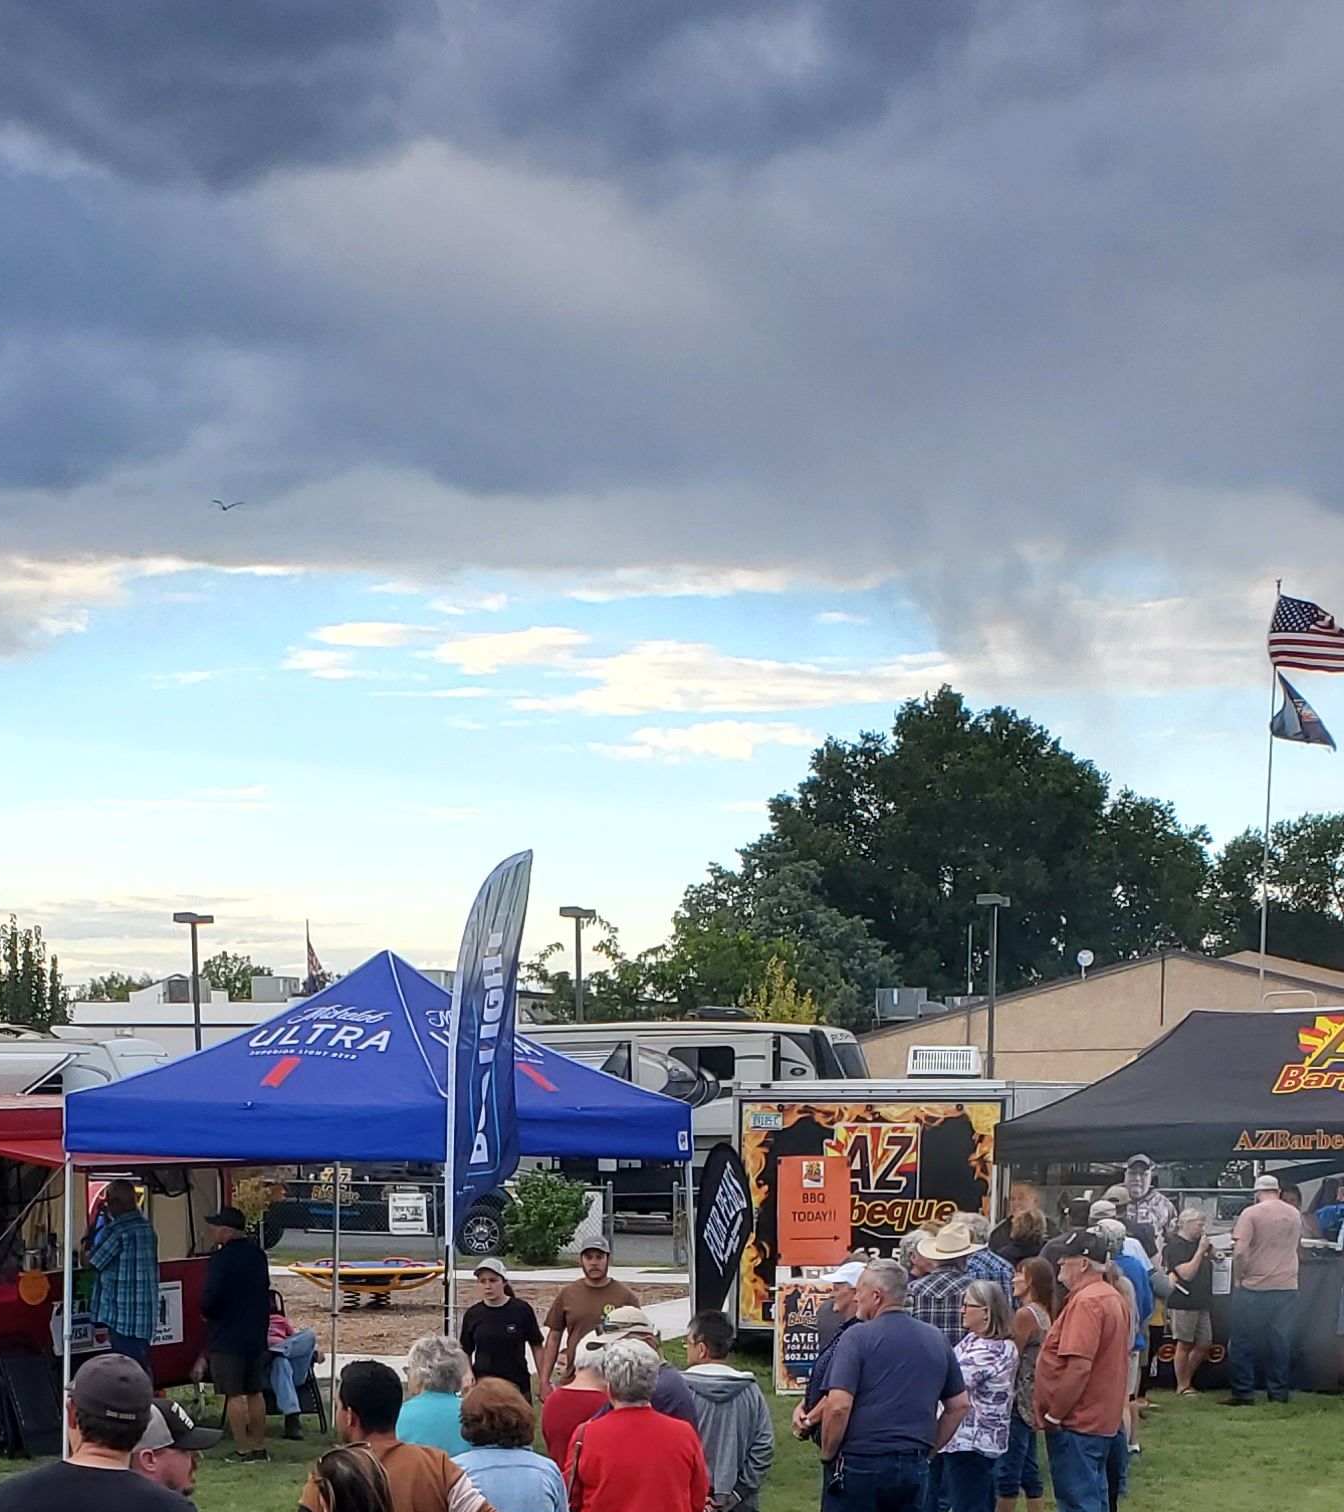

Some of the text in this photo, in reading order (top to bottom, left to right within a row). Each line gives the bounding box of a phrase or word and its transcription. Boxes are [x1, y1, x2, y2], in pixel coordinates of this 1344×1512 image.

[287, 1004, 392, 1024] Michelob
[248, 1022, 392, 1052] ULTRA
[849, 1132, 916, 1192] AZ
[802, 1193, 825, 1204] BBQ
[850, 1195, 959, 1231] beque
